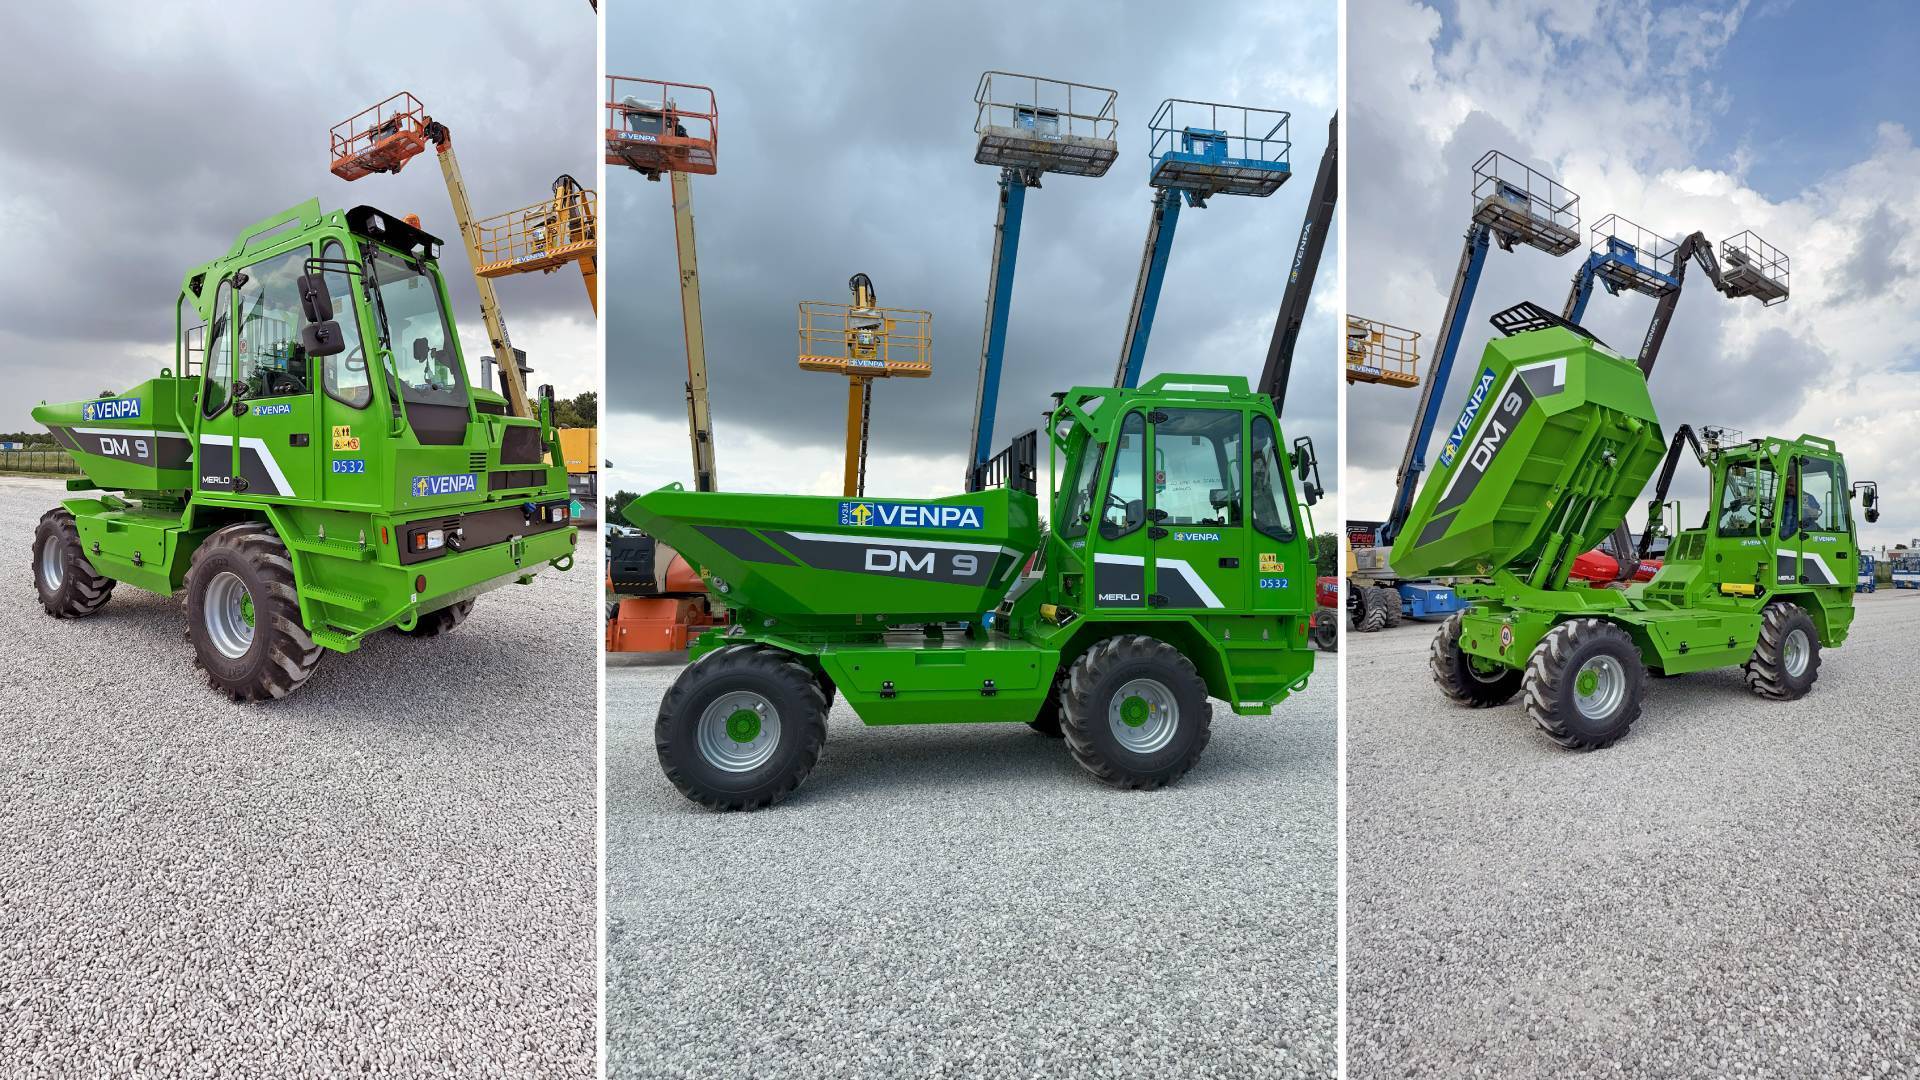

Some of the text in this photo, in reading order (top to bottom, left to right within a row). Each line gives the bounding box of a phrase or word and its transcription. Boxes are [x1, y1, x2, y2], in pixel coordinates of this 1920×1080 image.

[628, 133, 656, 142] VENPA
[1295, 222, 1311, 267] VENPA
[96, 400, 139, 418] VENPA
[261, 404, 290, 414] VENPA
[1452, 375, 1494, 440] VENPA
[1470, 392, 1523, 473] DM 9
[100, 437, 149, 458] DM 9
[333, 460, 364, 473] D532
[202, 476, 230, 484] MERLO
[431, 475, 475, 494] VENPA
[877, 504, 980, 528] VENPA
[1186, 532, 1219, 541] VENPA
[864, 548, 978, 576] DM 9
[1259, 579, 1288, 588] D532
[1098, 593, 1140, 601] MERLO
